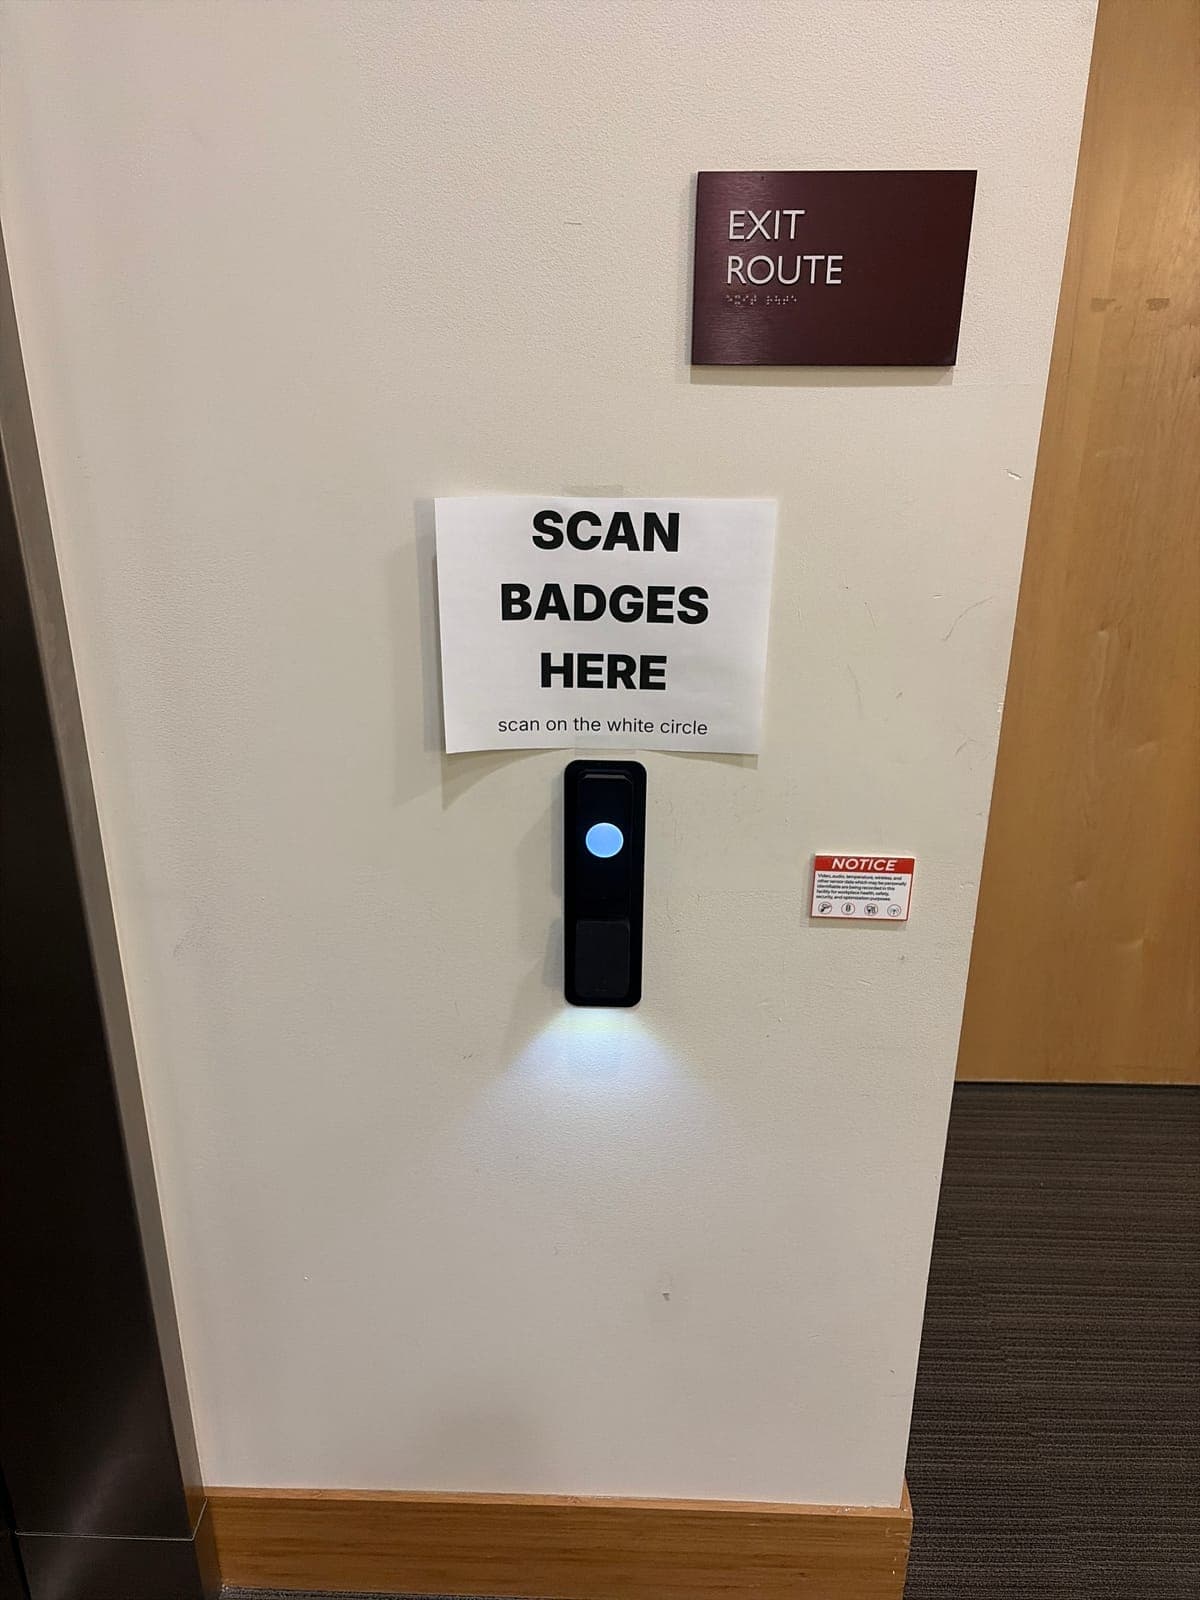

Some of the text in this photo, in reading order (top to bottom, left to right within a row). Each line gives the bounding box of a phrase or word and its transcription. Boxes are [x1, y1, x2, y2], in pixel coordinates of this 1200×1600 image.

[728, 209, 806, 241] EXIT
[726, 255, 844, 286] ROUTE
[532, 509, 680, 552] SCAN
[501, 583, 709, 625] BADGES
[540, 652, 668, 691] HERE
[498, 717, 708, 736] scan on the white circle
[831, 858, 898, 871] NOTICE
